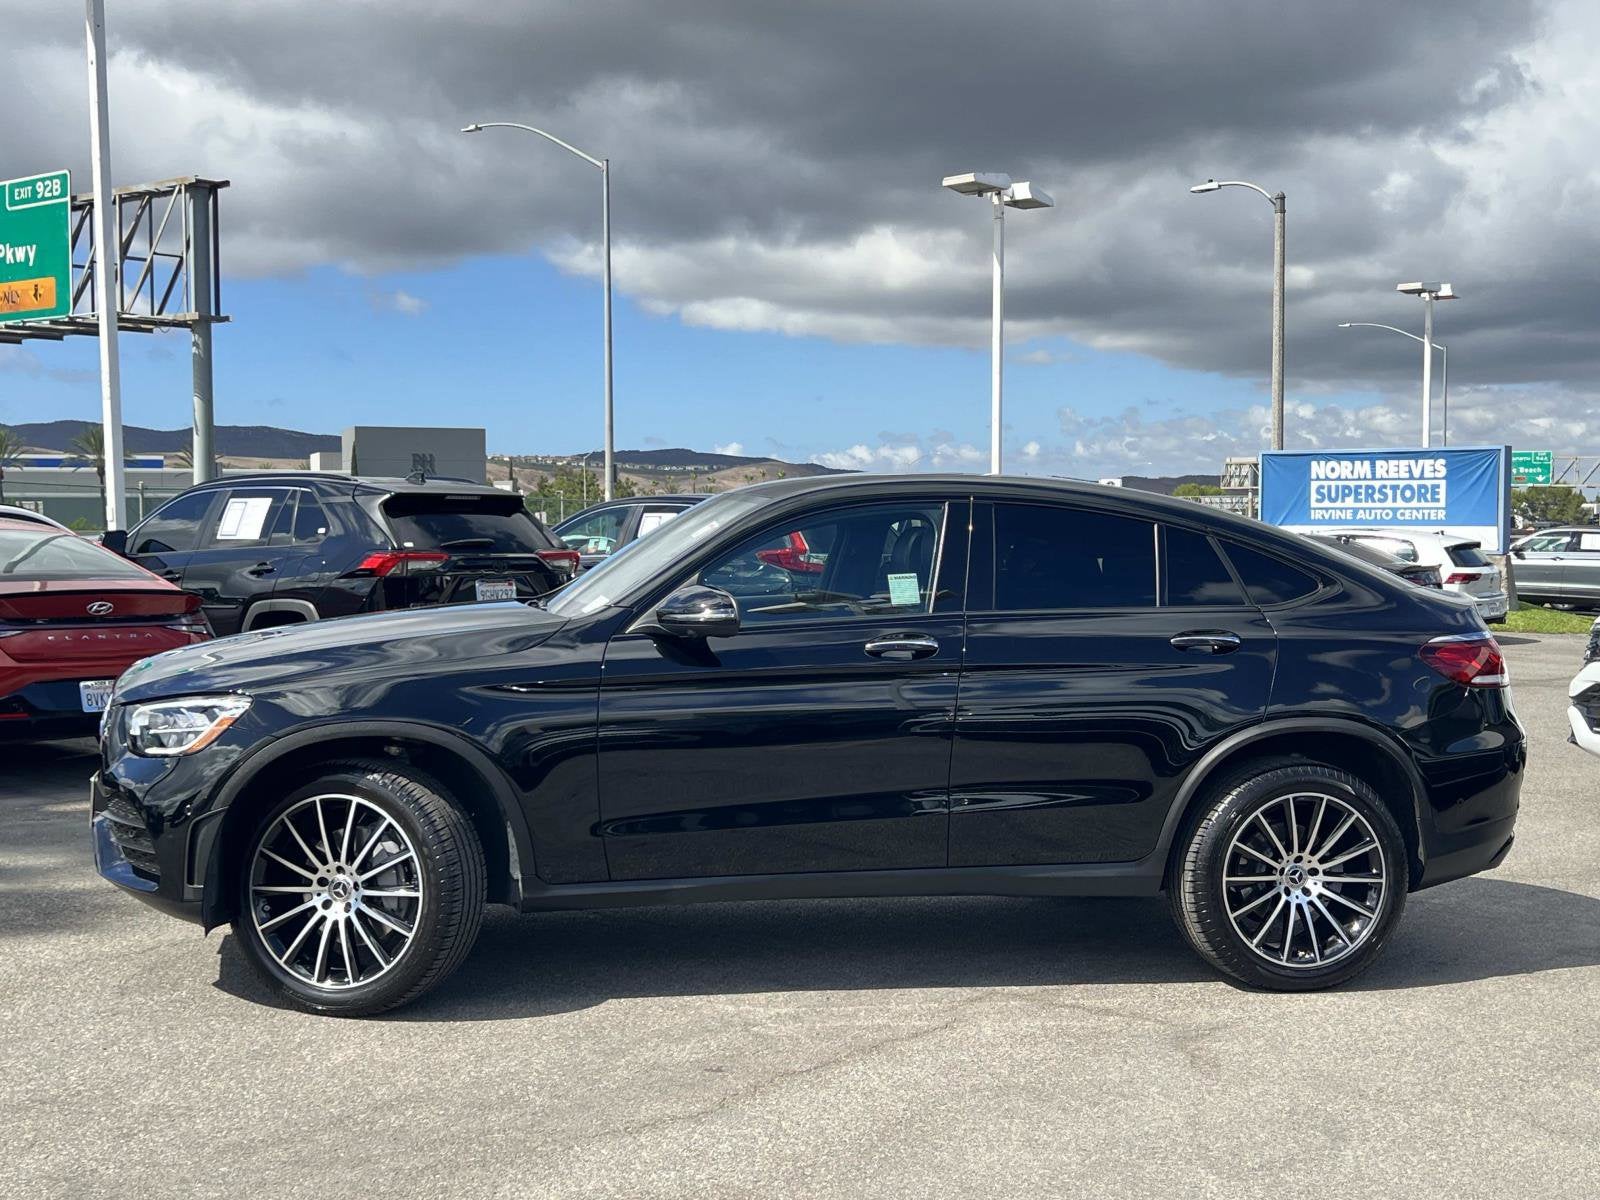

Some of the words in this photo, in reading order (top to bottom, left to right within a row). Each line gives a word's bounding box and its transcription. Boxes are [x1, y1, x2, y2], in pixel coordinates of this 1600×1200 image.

[14, 186, 32, 200] EXIT
[36, 179, 61, 198] 92B
[1311, 460, 1372, 479] NORM
[1375, 459, 1447, 479] REEVES
[1315, 484, 1441, 503] SUPERSTORE
[1311, 509, 1354, 520] IRVINE
[1356, 509, 1393, 520] AUTO
[1396, 509, 1446, 521] CENTER
[47, 632, 152, 640] ELANTRA
